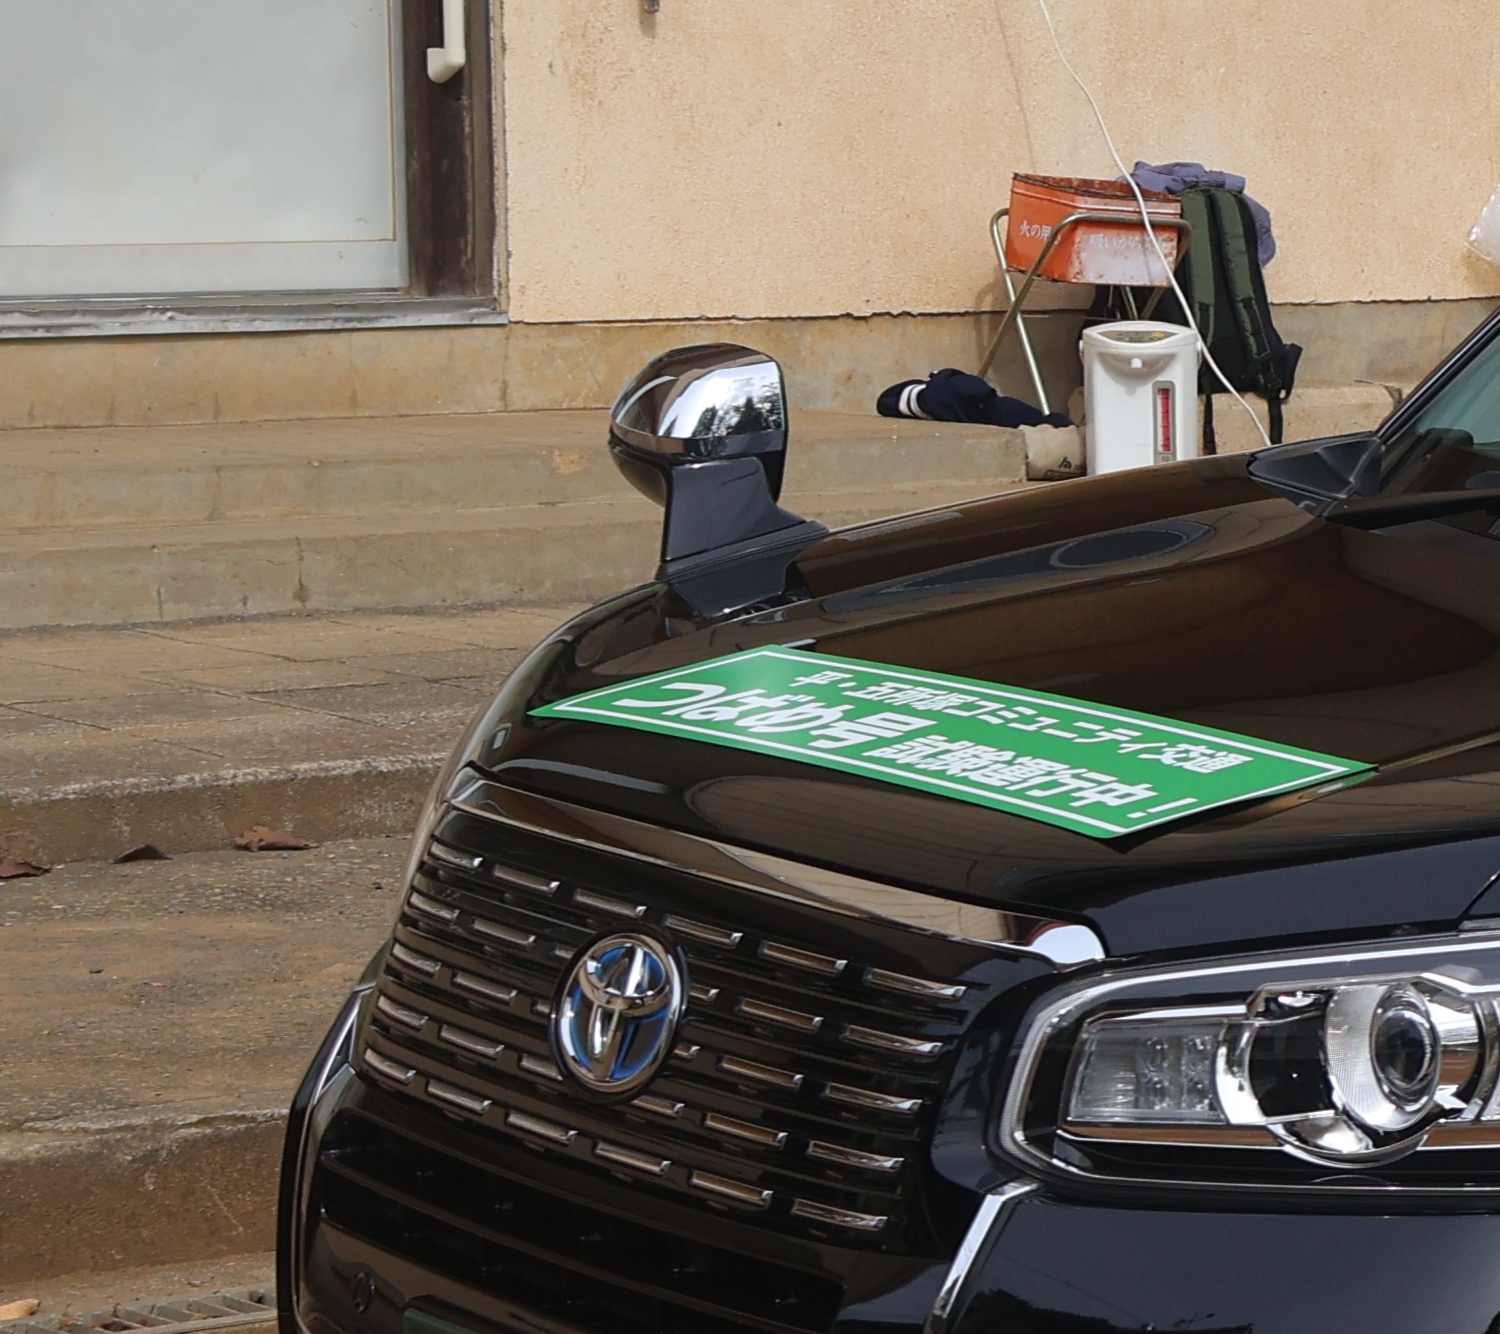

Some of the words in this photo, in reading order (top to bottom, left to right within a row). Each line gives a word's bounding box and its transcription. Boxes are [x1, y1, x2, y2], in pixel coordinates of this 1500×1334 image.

[1020, 220, 1061, 245] 火の用
[610, 682, 938, 750] つばめ号
[861, 734, 1199, 819] 試験運行中！
